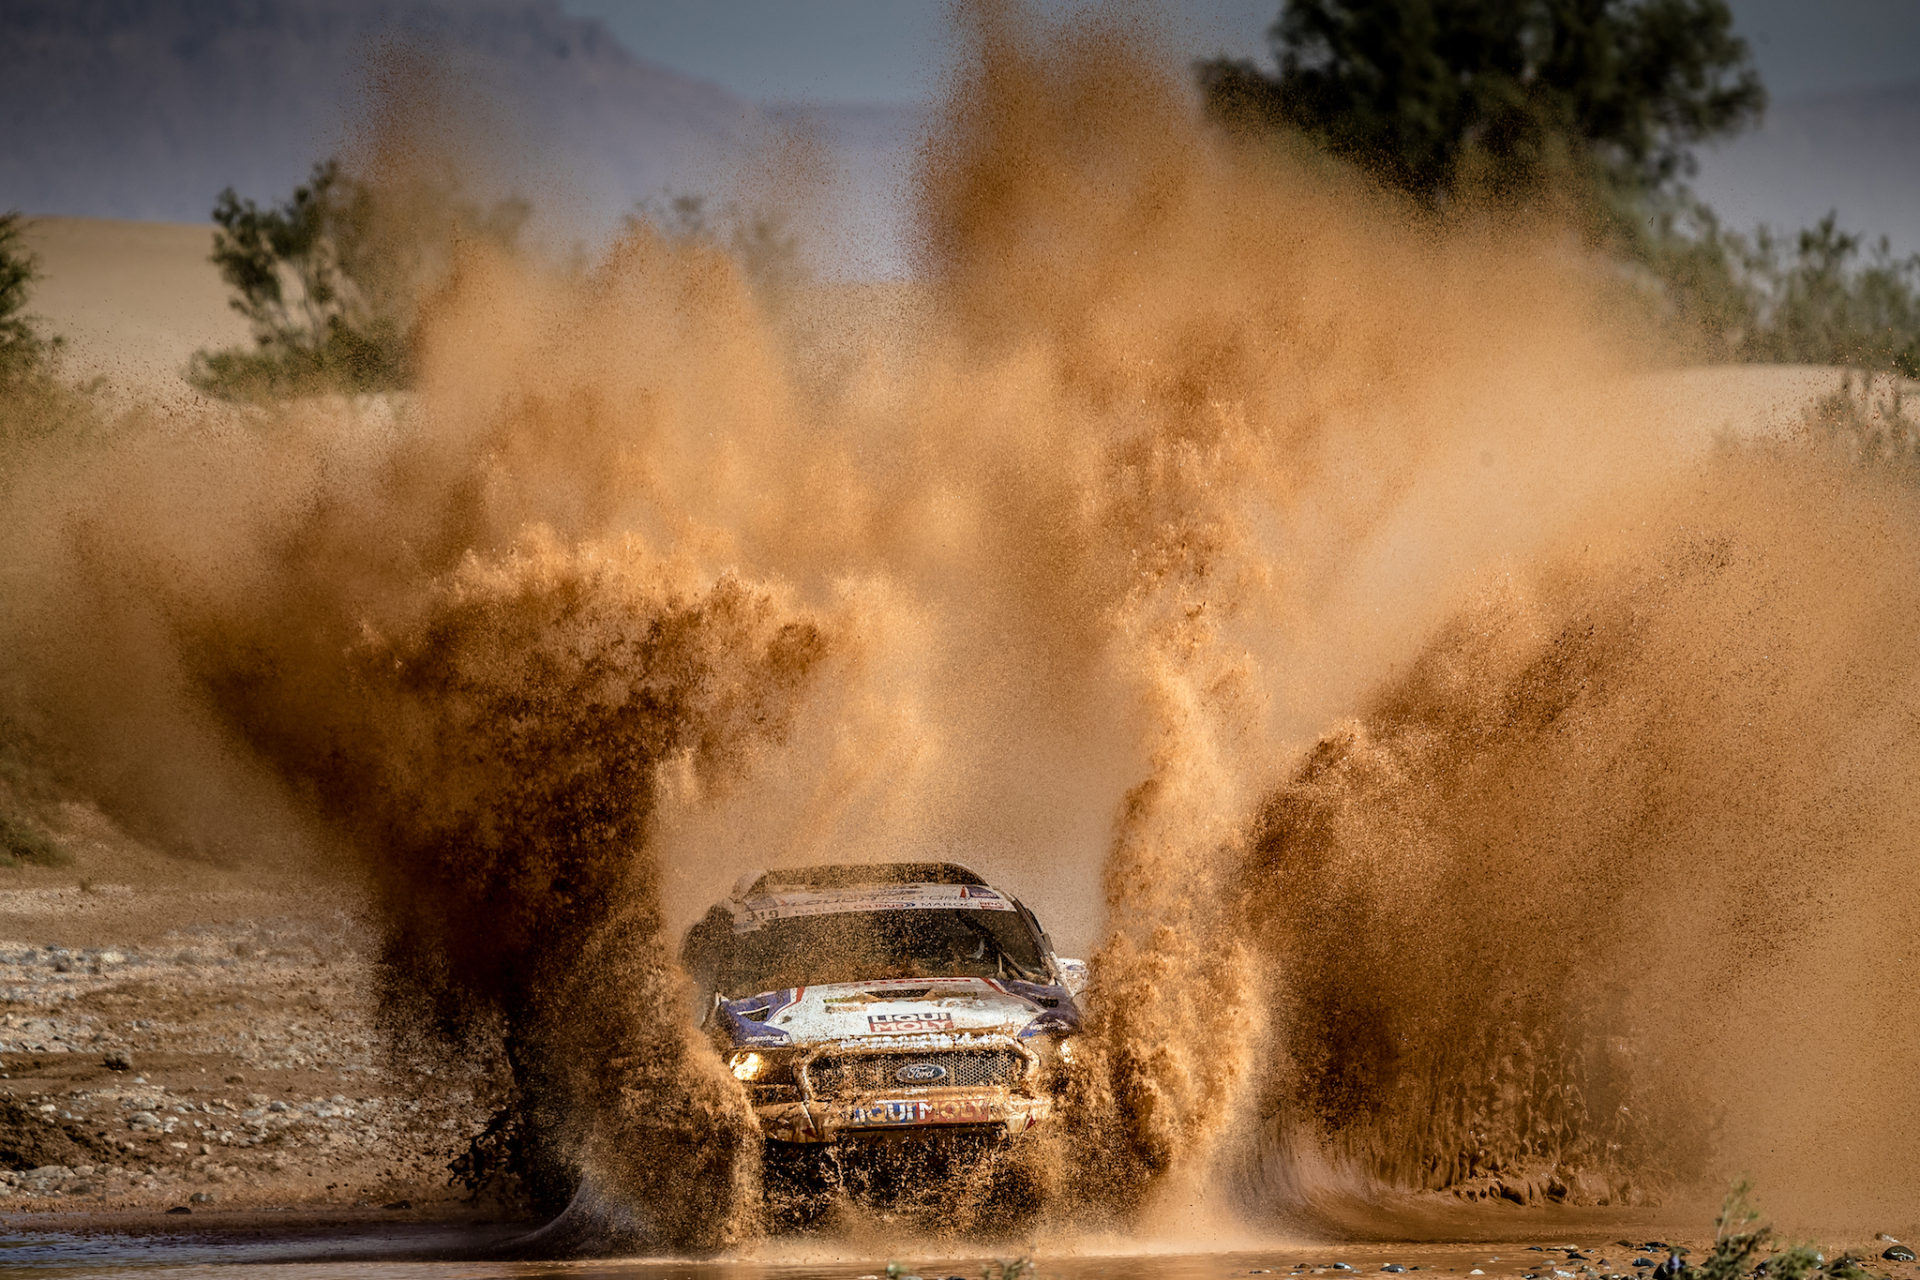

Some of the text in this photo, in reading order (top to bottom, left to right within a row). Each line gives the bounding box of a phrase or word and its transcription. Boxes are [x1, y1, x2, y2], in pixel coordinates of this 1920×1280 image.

[870, 1013, 949, 1023] LIQUI
[873, 1020, 949, 1032] MOLY
[908, 1066, 935, 1079] Ford
